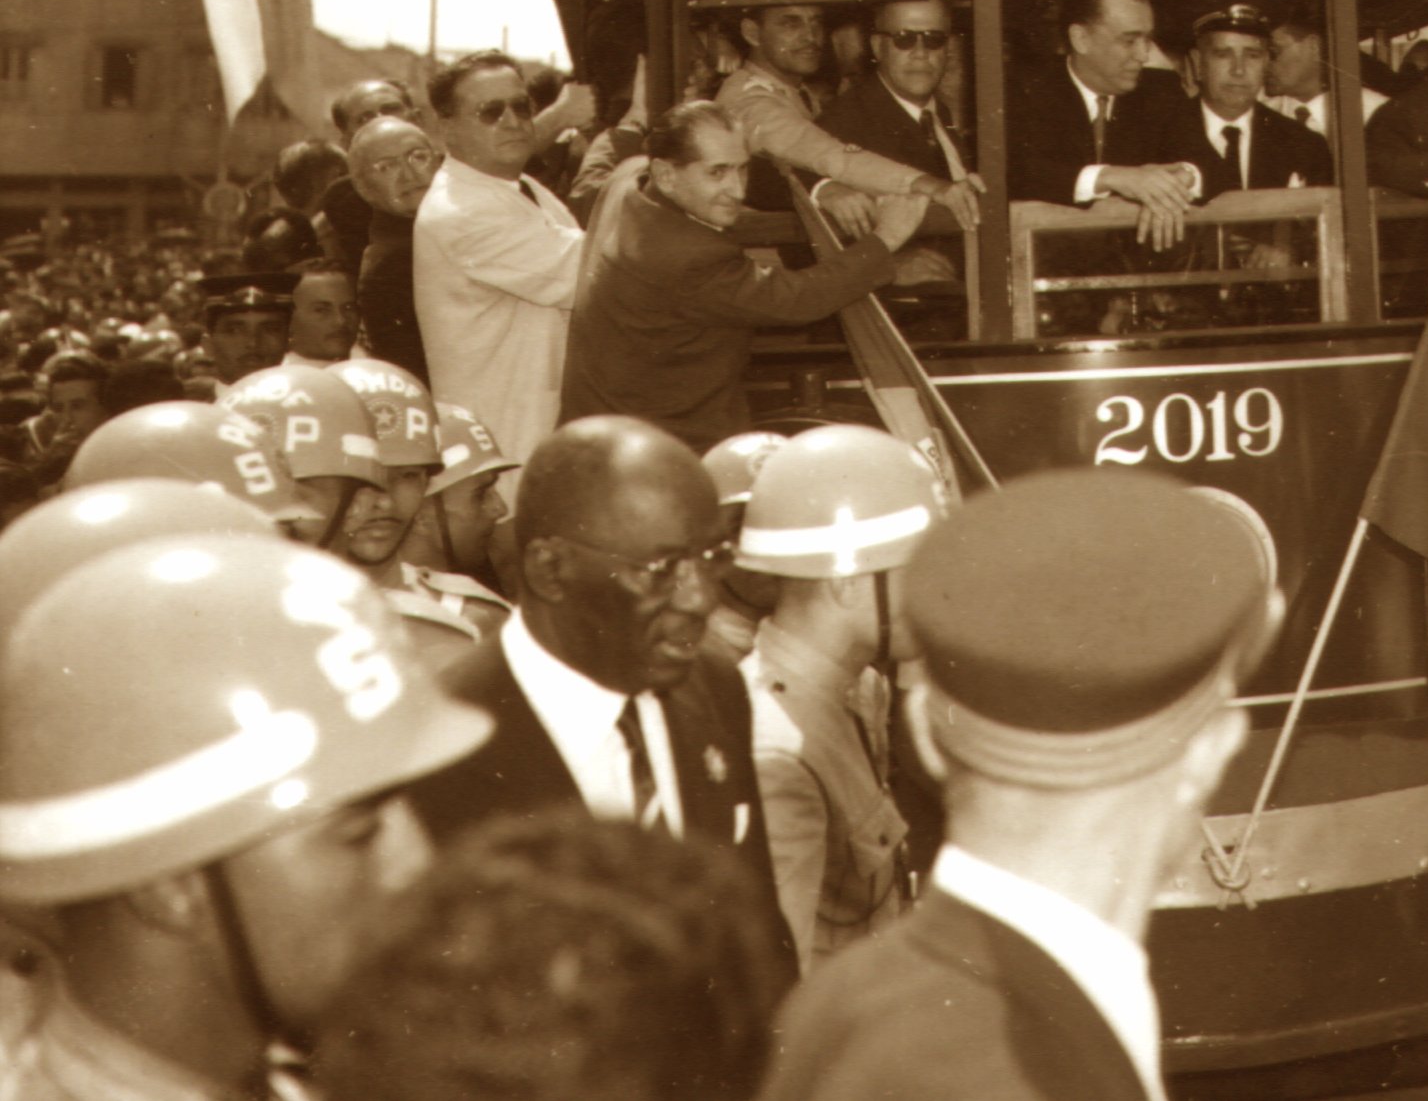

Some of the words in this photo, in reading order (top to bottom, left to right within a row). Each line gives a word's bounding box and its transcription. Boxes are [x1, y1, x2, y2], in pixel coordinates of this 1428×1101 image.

[286, 415, 320, 452] P
[406, 407, 429, 440] P
[1095, 387, 1284, 465] 2019
[234, 451, 277, 495] S
